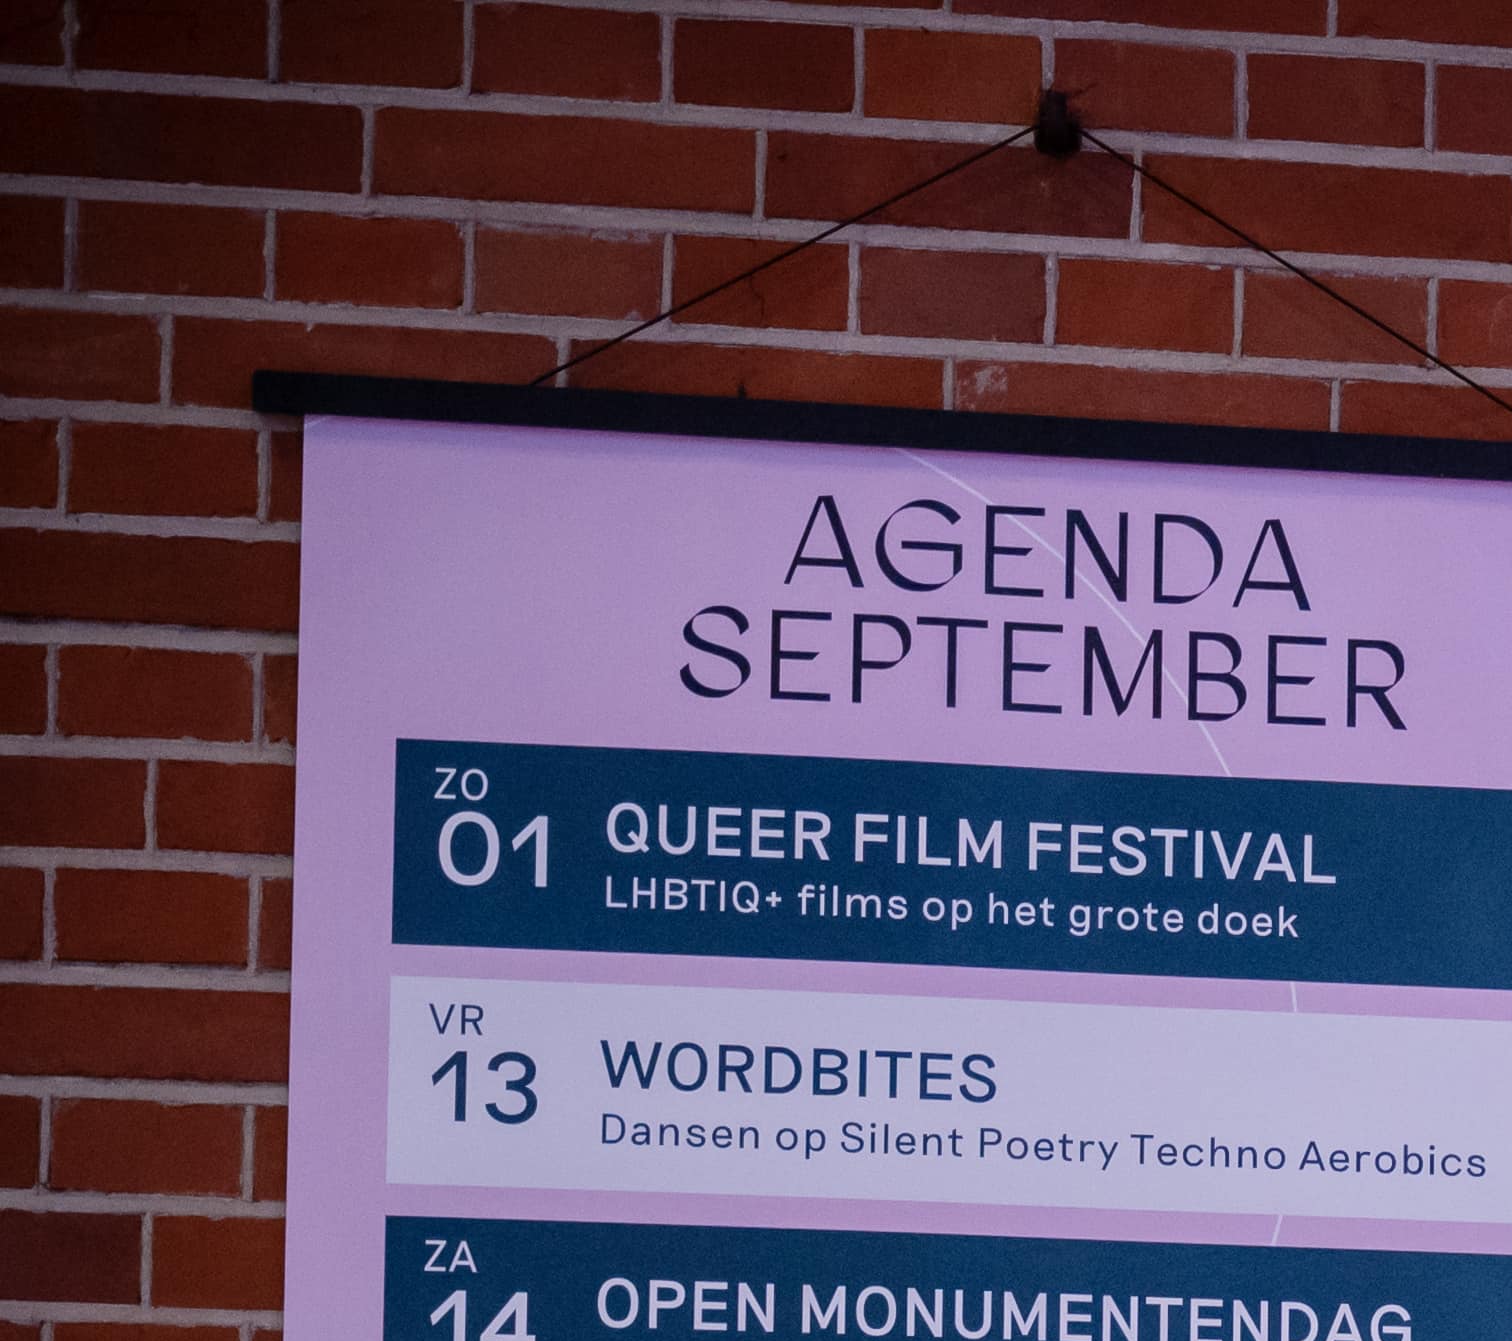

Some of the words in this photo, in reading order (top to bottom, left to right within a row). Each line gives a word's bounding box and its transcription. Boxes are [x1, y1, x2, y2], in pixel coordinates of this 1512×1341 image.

[783, 494, 1311, 612] AGENDA
[679, 605, 1407, 731] SEPTEMBER
[433, 767, 489, 801] ZO
[438, 810, 549, 888] 01
[606, 802, 831, 861] QUEER
[854, 813, 1003, 869] FILM
[1028, 821, 1337, 884] FESTIVAL
[605, 875, 782, 914] LHBTIQ+
[797, 884, 908, 920] films
[922, 897, 973, 931] op
[988, 892, 1055, 927] het
[1069, 902, 1184, 937] grote
[1197, 902, 1299, 938] doek
[429, 1003, 484, 1036] VR
[431, 1050, 538, 1125] 13
[600, 1039, 997, 1103] WORDBITES
[601, 1113, 760, 1149] Dansen
[775, 1127, 826, 1160] op
[840, 1121, 964, 1158] Silent
[979, 1127, 1119, 1171] Poetry
[1130, 1134, 1286, 1170] Techno
[1298, 1140, 1486, 1178] Aerobics
[423, 1239, 478, 1273] ZA
[597, 1277, 775, 1333] OPEN
